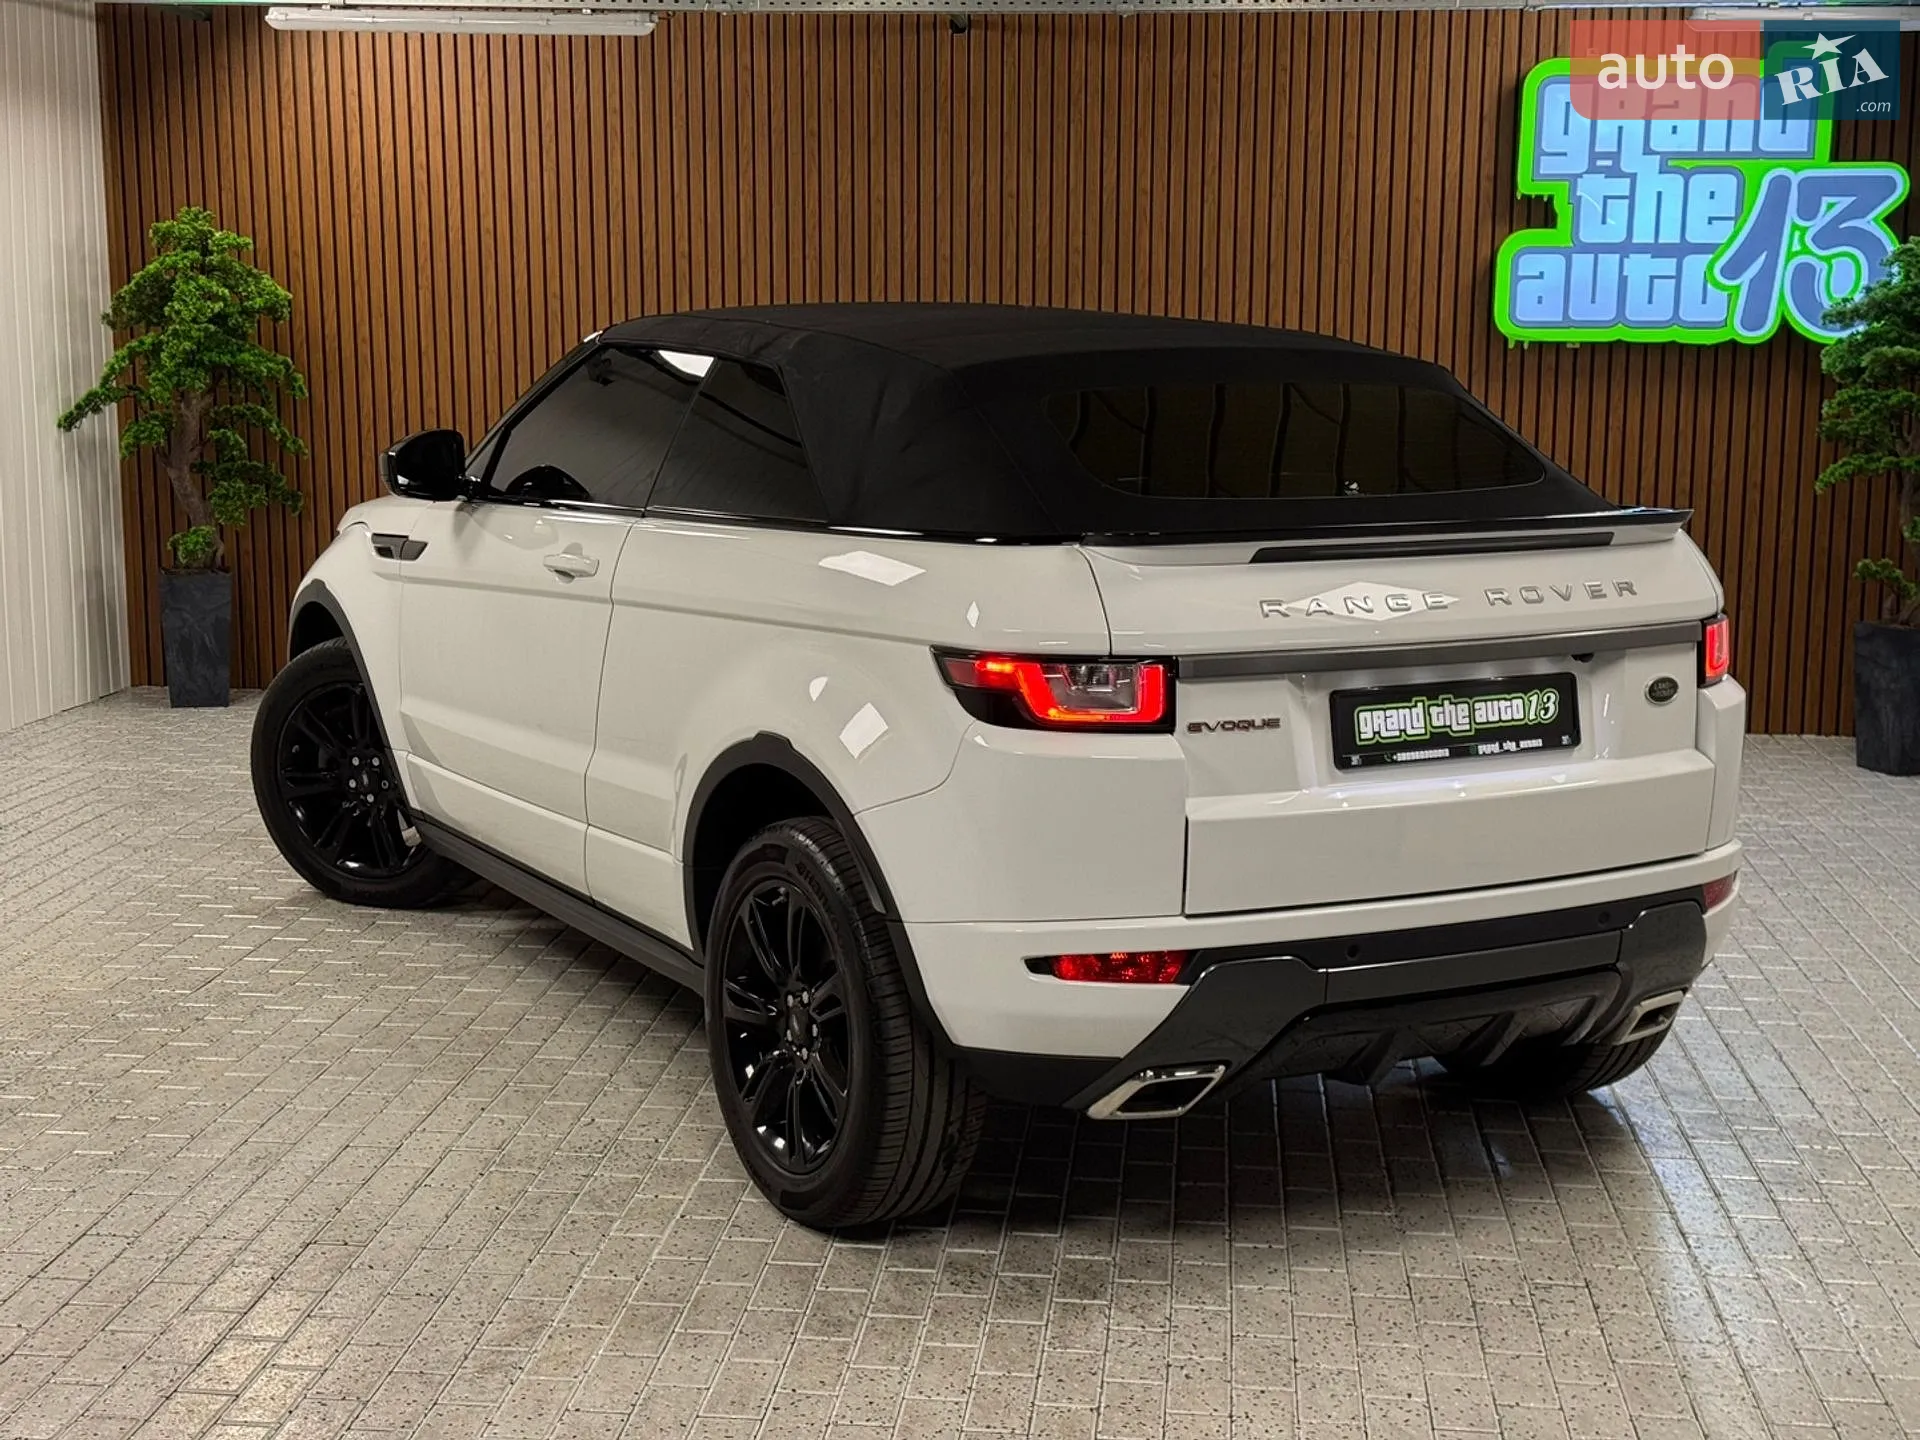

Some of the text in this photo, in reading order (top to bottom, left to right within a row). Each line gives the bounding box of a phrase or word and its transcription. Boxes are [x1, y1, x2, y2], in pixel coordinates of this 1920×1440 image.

[1577, 160, 1739, 244] the
[1515, 168, 1905, 337] auto 13
[1259, 579, 1638, 619] RANGE ROVER
[1187, 718, 1281, 733] EVOQUE
[1358, 690, 1558, 739] grand the auto 13
